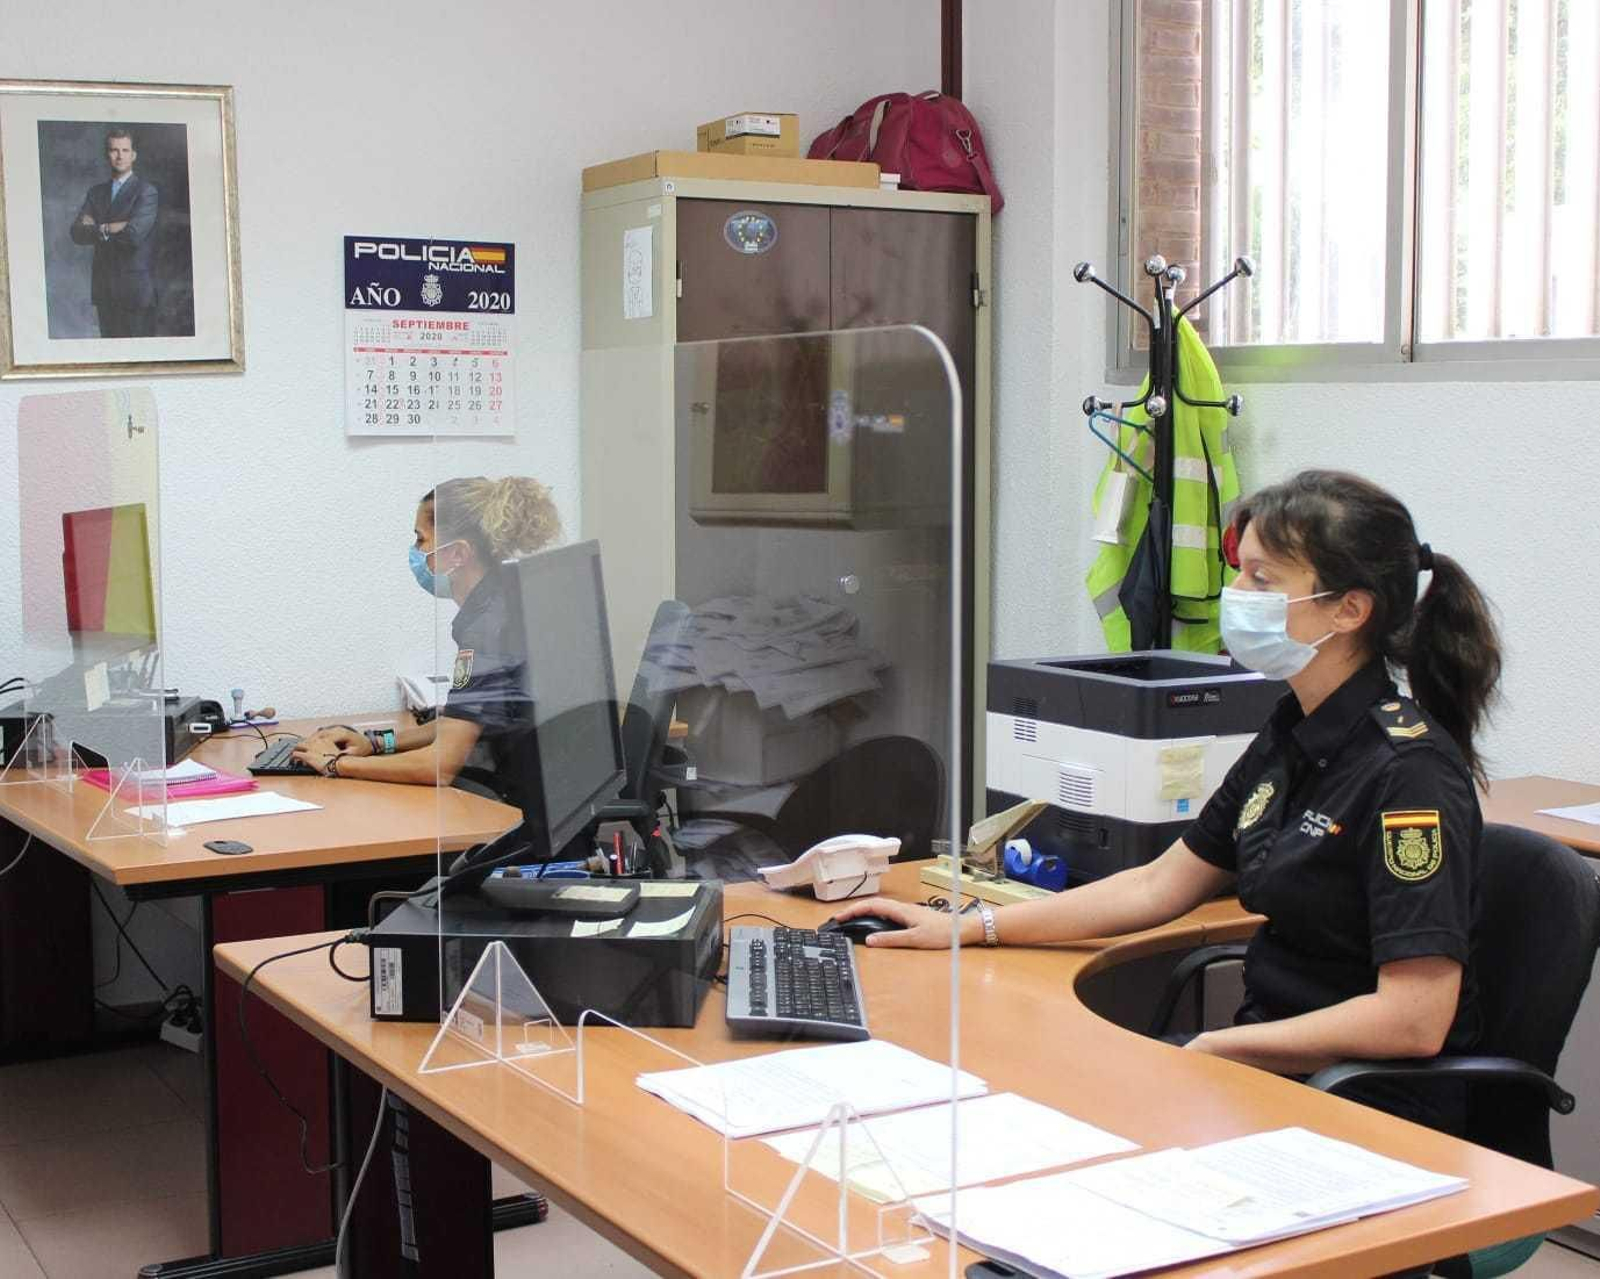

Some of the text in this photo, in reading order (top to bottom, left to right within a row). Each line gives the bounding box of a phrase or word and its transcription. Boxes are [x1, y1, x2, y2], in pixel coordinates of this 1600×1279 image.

[354, 242, 475, 263] POLICIA
[428, 262, 505, 273] NACIONAL
[350, 282, 511, 310] AÑO 2020
[392, 319, 470, 331] SEPTIEMBRE
[420, 332, 443, 341] 2020
[389, 356, 395, 366] 1
[410, 357, 417, 366] 2
[431, 357, 438, 367] 3
[367, 370, 502, 382] 7 8 9 10 11 12 13
[365, 384, 378, 394] 14
[386, 385, 399, 395] 15
[407, 385, 420, 395] 16
[450, 386, 461, 396] 18
[469, 386, 482, 396] 19
[489, 387, 502, 397] 20
[364, 399, 377, 409] 21
[386, 399, 399, 410] 22
[407, 400, 421, 410] 23
[448, 400, 461, 410] 25
[468, 400, 482, 411] 26
[489, 400, 502, 411] 27
[365, 414, 378, 424] 28
[386, 414, 399, 424] 29
[407, 414, 421, 425] 30
